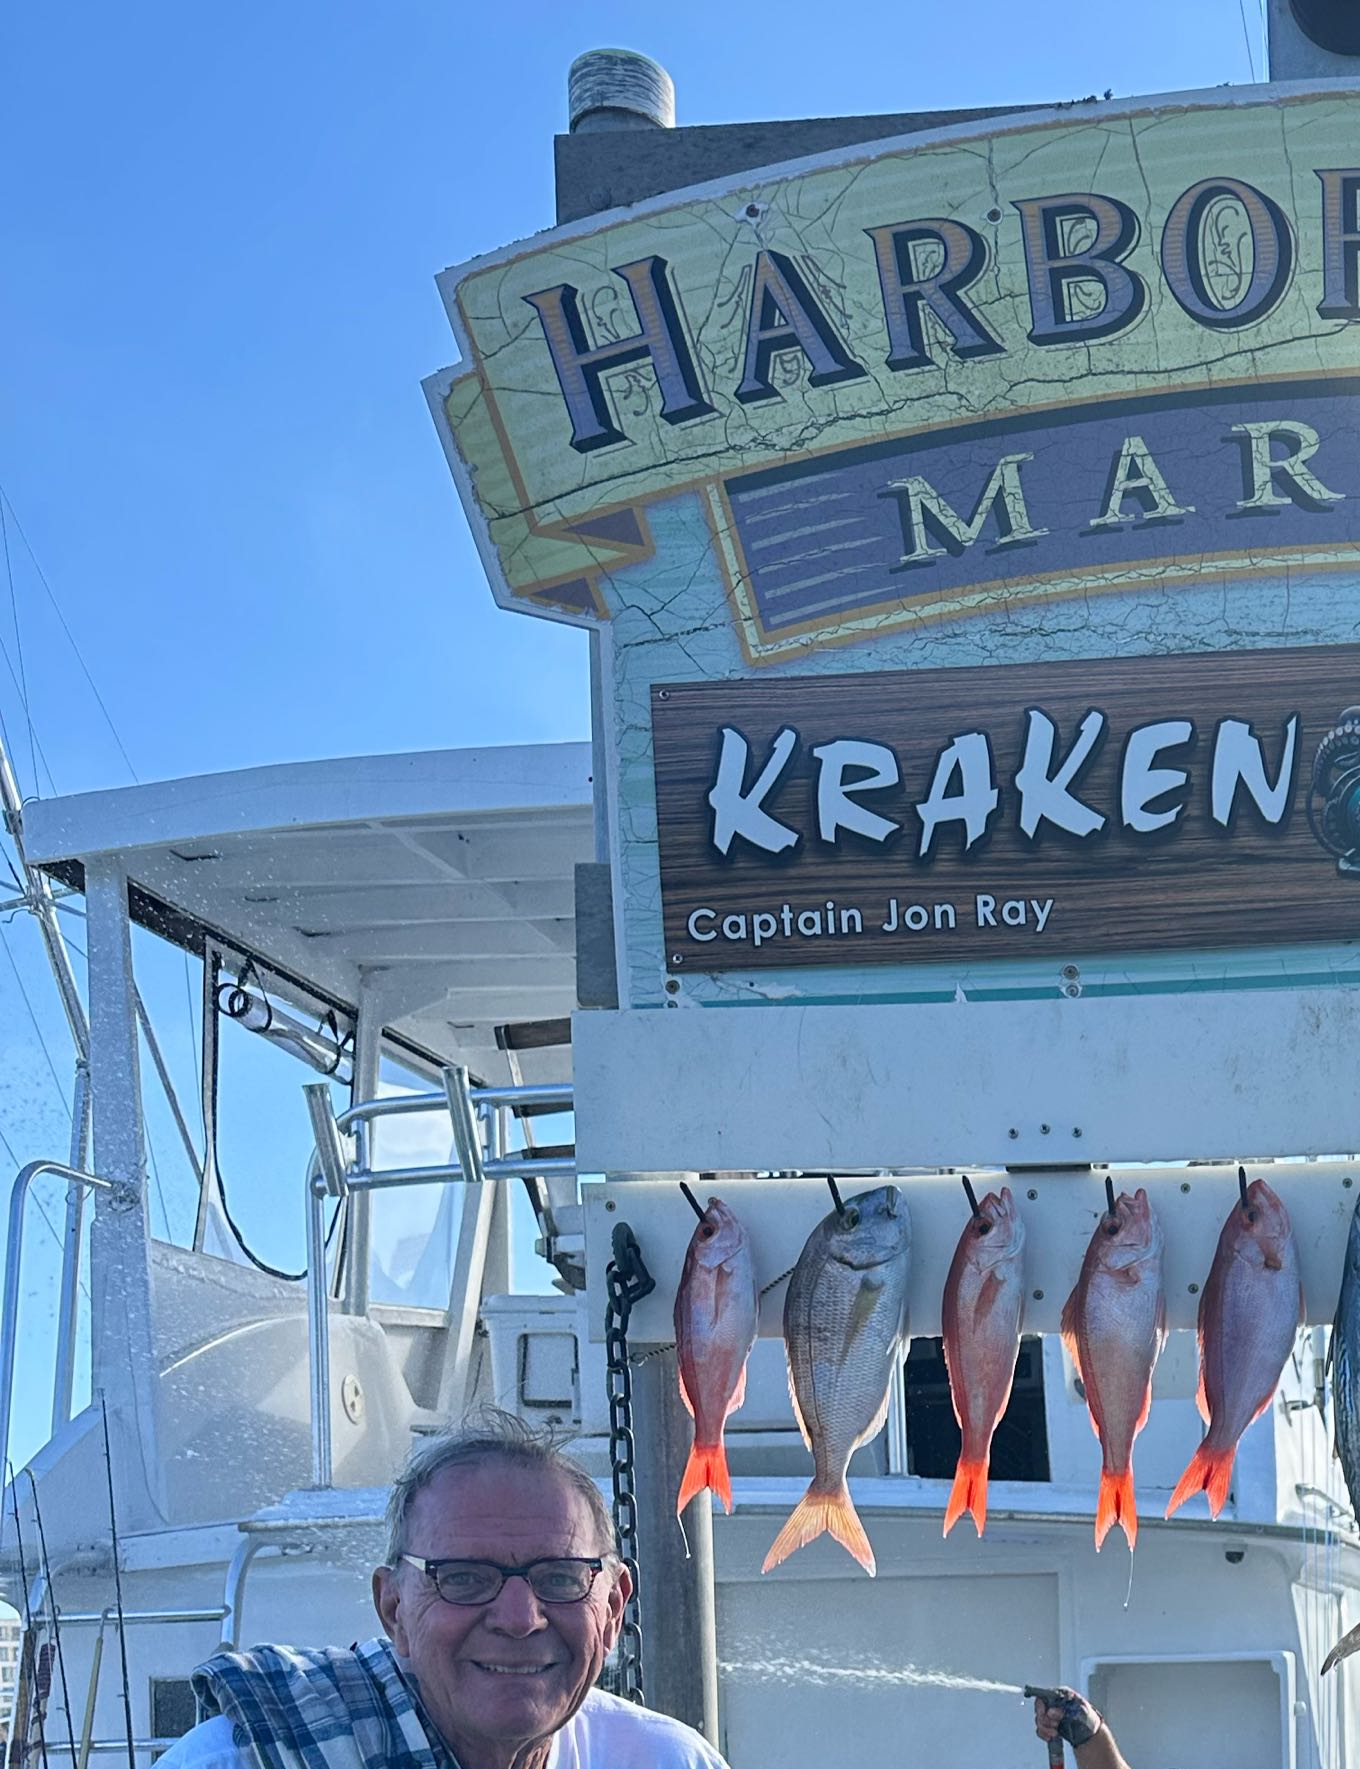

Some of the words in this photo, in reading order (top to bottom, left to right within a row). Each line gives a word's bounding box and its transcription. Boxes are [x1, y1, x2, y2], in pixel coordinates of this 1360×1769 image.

[708, 708, 1298, 858] KRAKEN
[688, 901, 862, 946] Captain
[882, 898, 956, 931] Jon
[976, 894, 1055, 933] Ray
